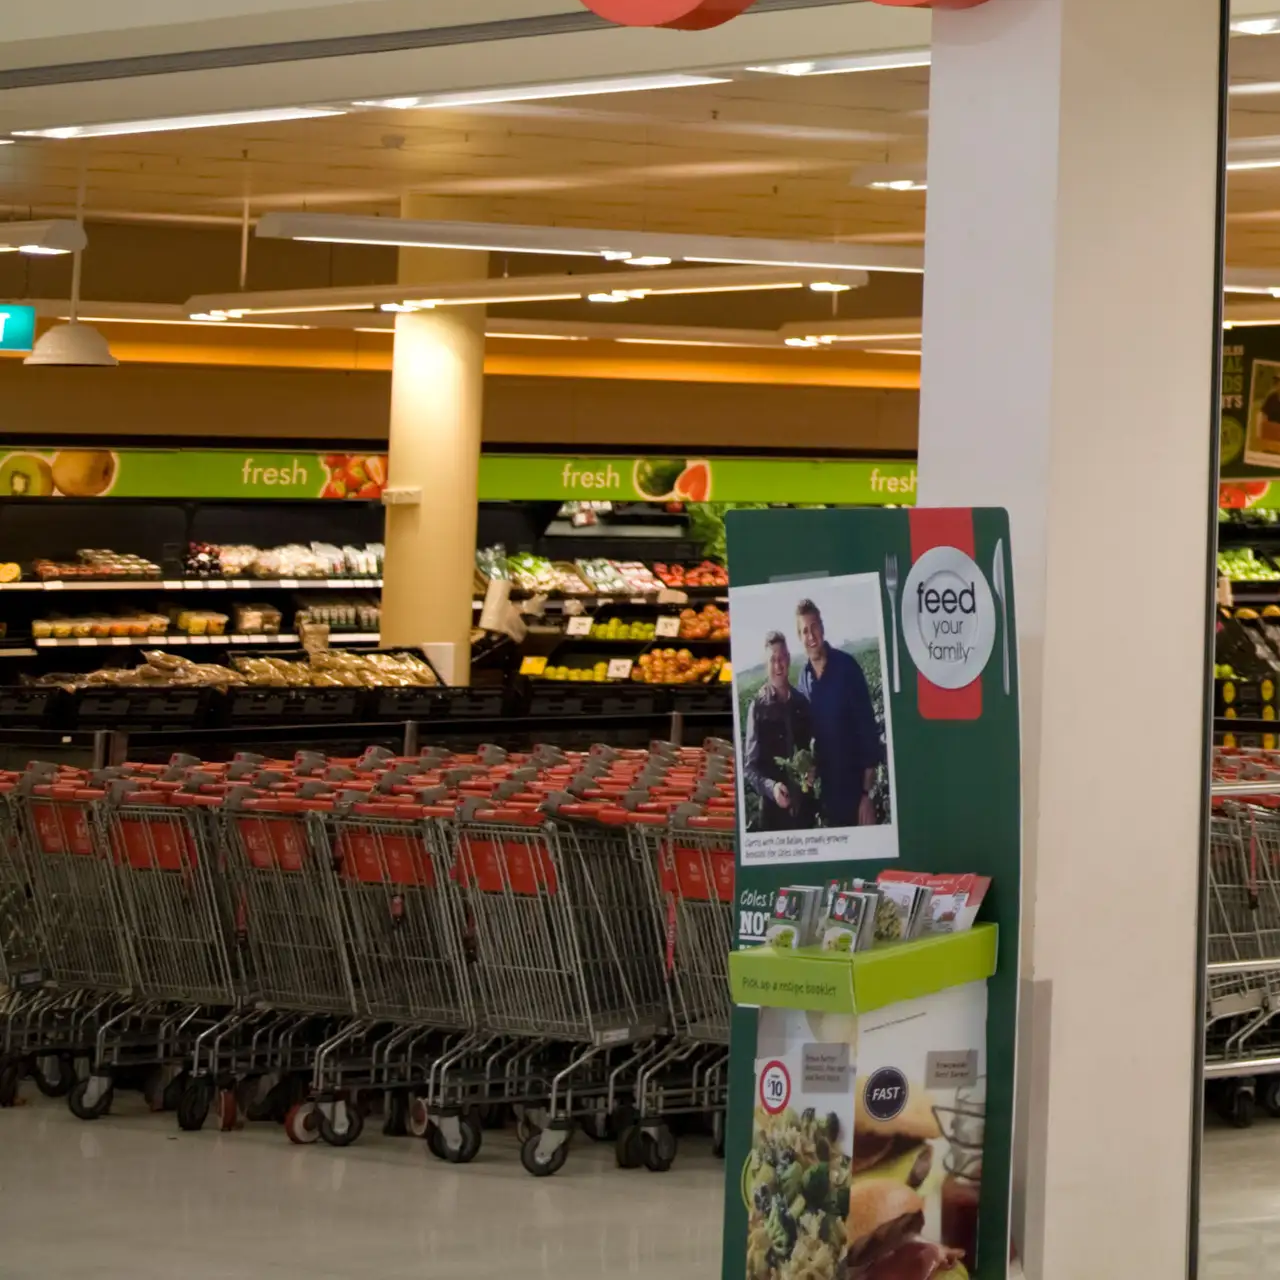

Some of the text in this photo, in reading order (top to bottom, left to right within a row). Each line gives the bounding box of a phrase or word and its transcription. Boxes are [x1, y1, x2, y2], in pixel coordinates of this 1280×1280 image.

[241, 459, 308, 487] fresh
[562, 462, 621, 490] fresh
[917, 581, 976, 614] feed
[933, 620, 963, 638] your
[928, 642, 970, 664] family
[740, 888, 767, 907] Coles
[739, 910, 771, 935] NO
[872, 1086, 901, 1102] FAST
